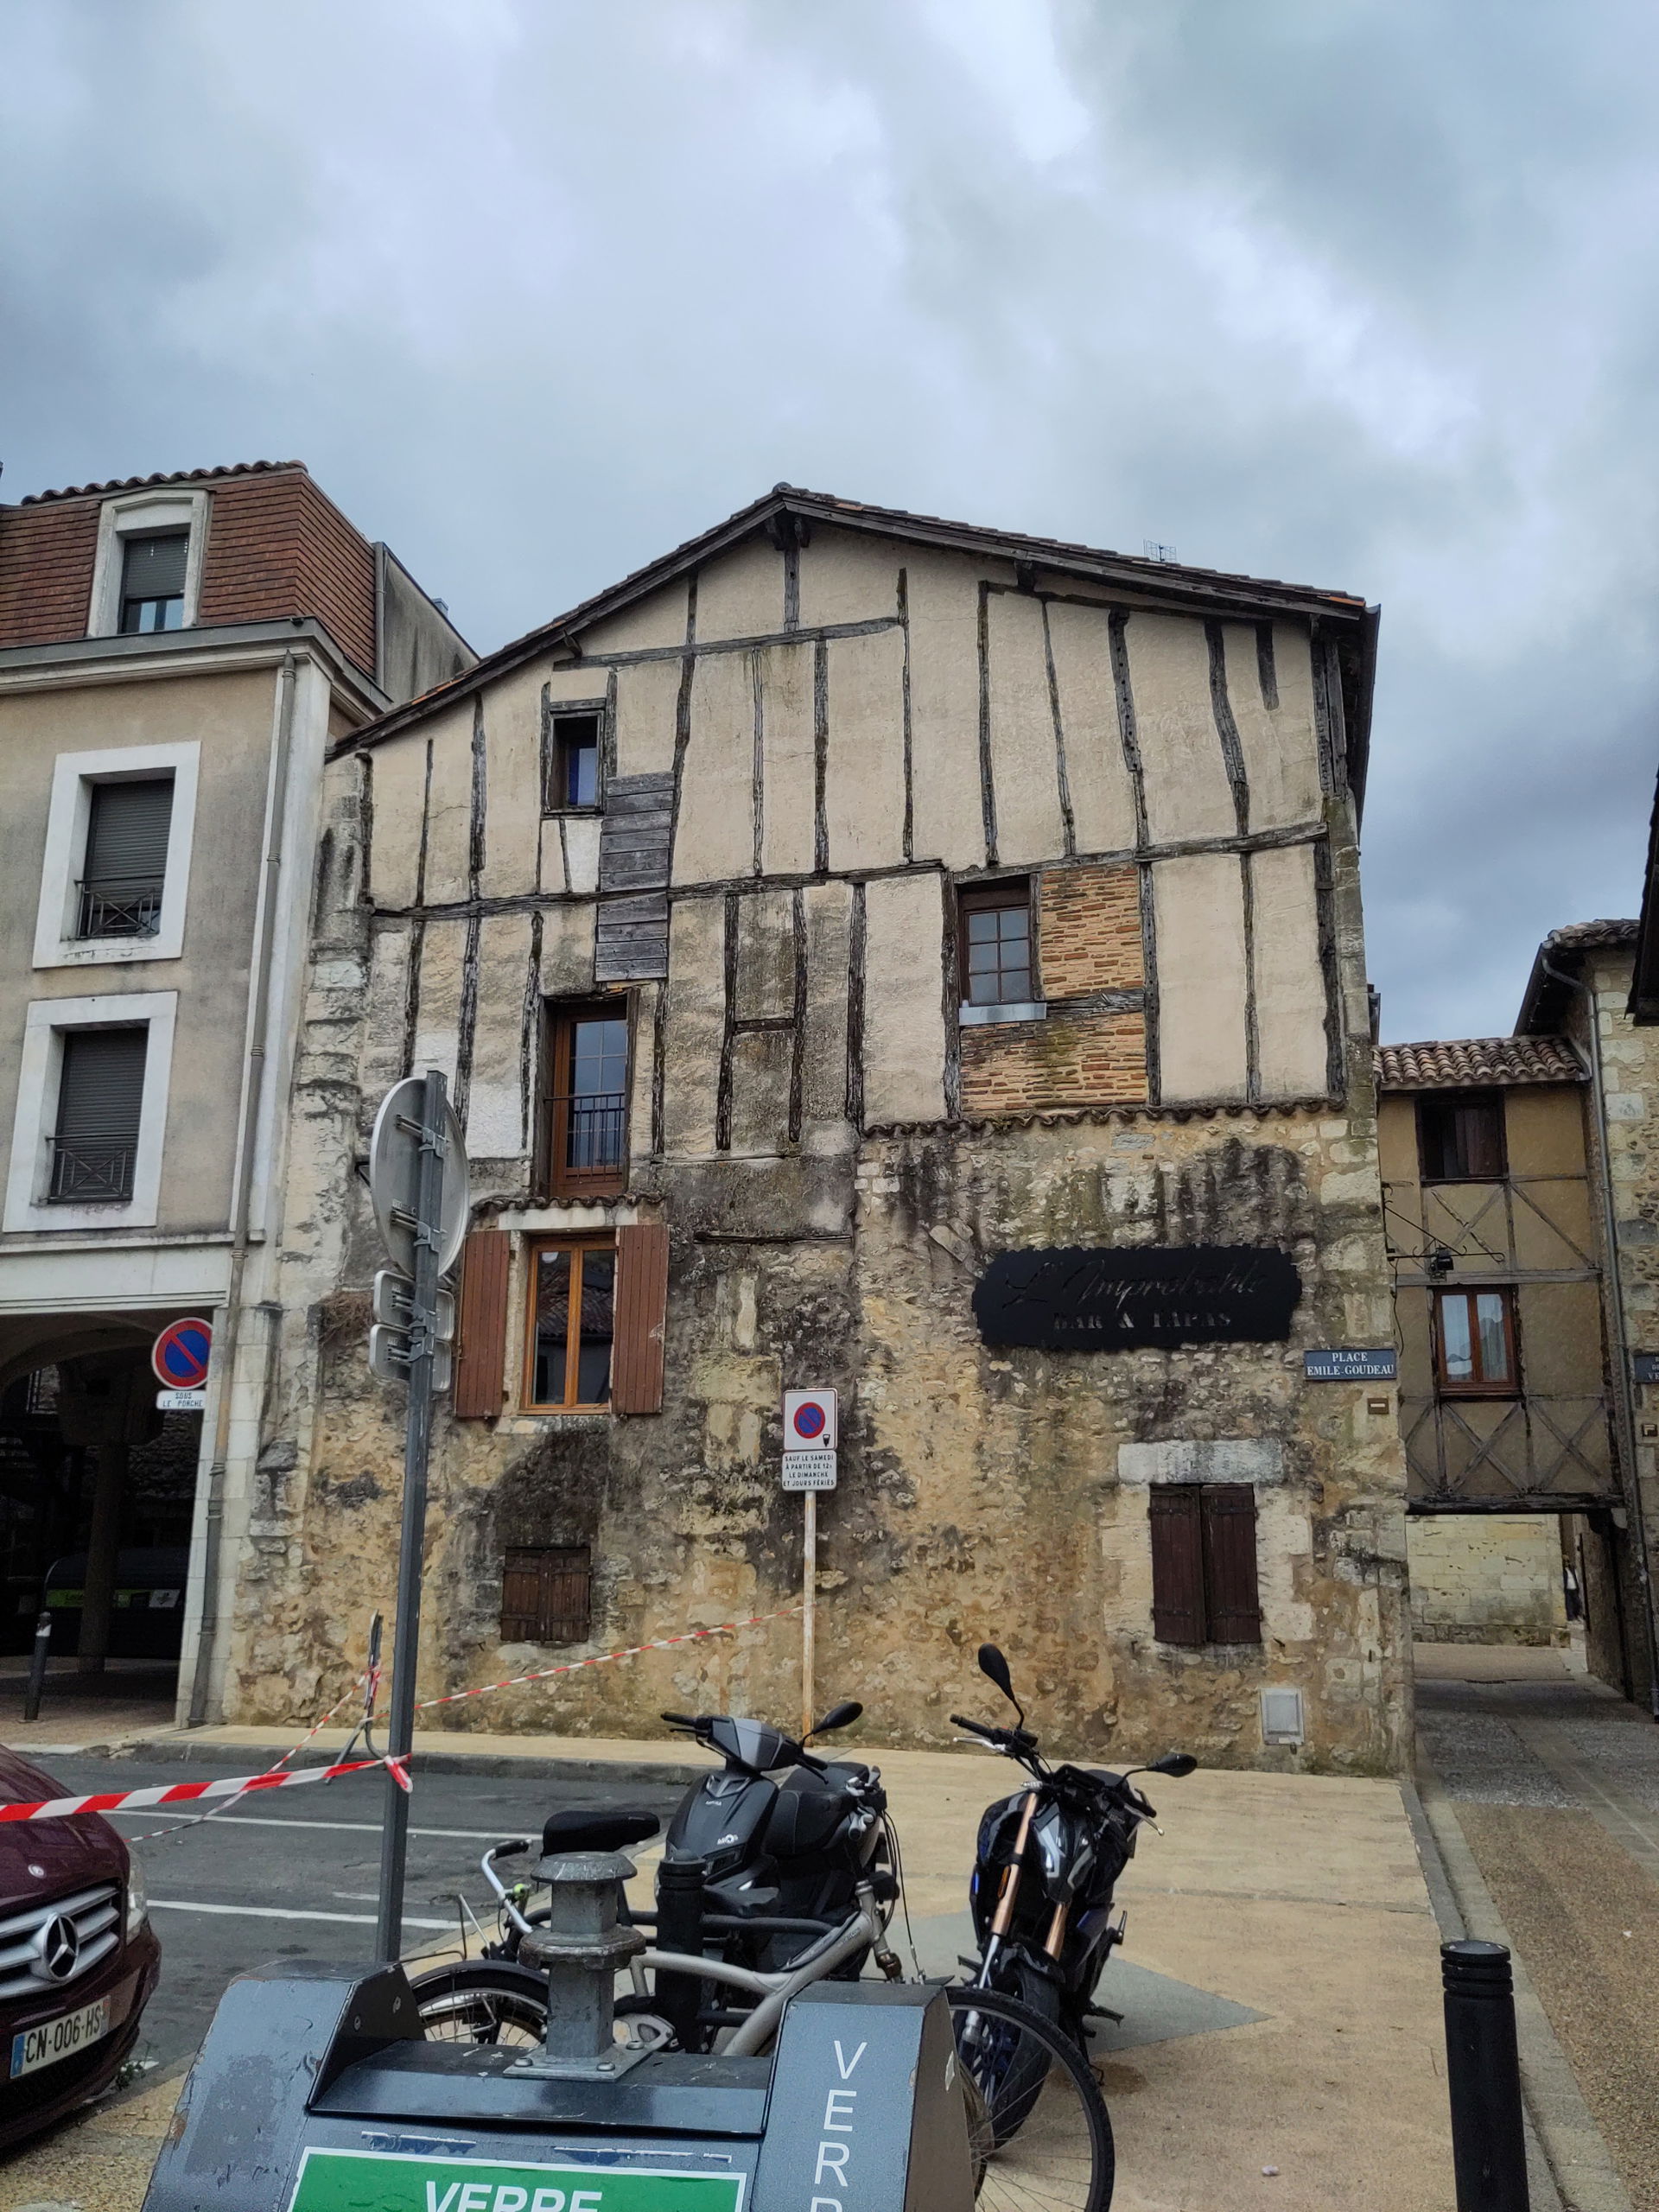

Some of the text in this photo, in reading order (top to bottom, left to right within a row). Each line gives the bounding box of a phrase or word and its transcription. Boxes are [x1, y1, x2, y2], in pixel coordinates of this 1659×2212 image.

[1053, 1312, 1104, 1330] BAR
[1151, 1311, 1232, 1328] TAPAS
[1332, 1352, 1368, 1363] PLACE
[1306, 1364, 1395, 1376] EMILE-GOUDEAU
[26, 2005, 101, 2063] CN-006-HS
